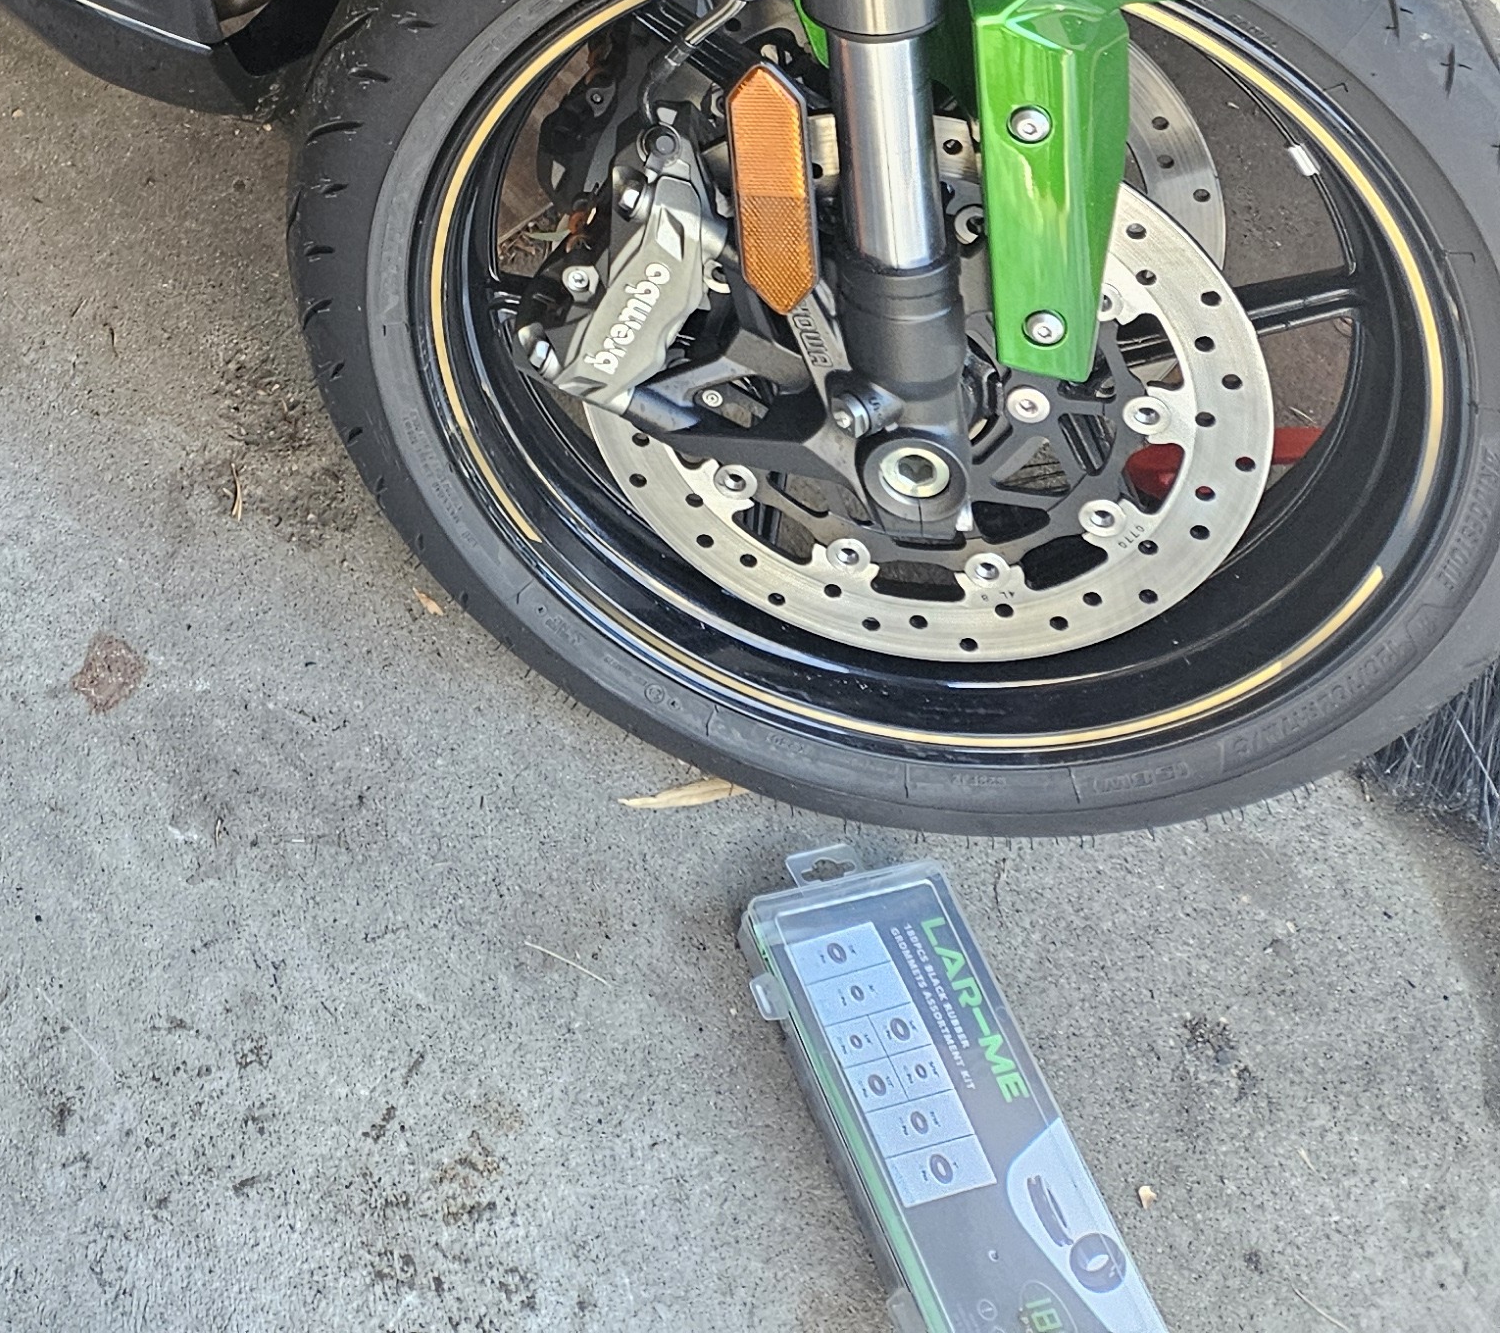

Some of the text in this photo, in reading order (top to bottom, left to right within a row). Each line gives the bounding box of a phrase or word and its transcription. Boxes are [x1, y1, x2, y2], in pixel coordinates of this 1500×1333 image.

[583, 262, 670, 374] brembo
[792, 300, 834, 368] OWA
[890, 928, 976, 1090] GROMMETS ASSORTMENT KIT
[904, 923, 971, 1048] 180PCS BLACK RUBBER
[920, 917, 1030, 1103] LAR-ME
[1024, 1296, 1066, 1333] 18
